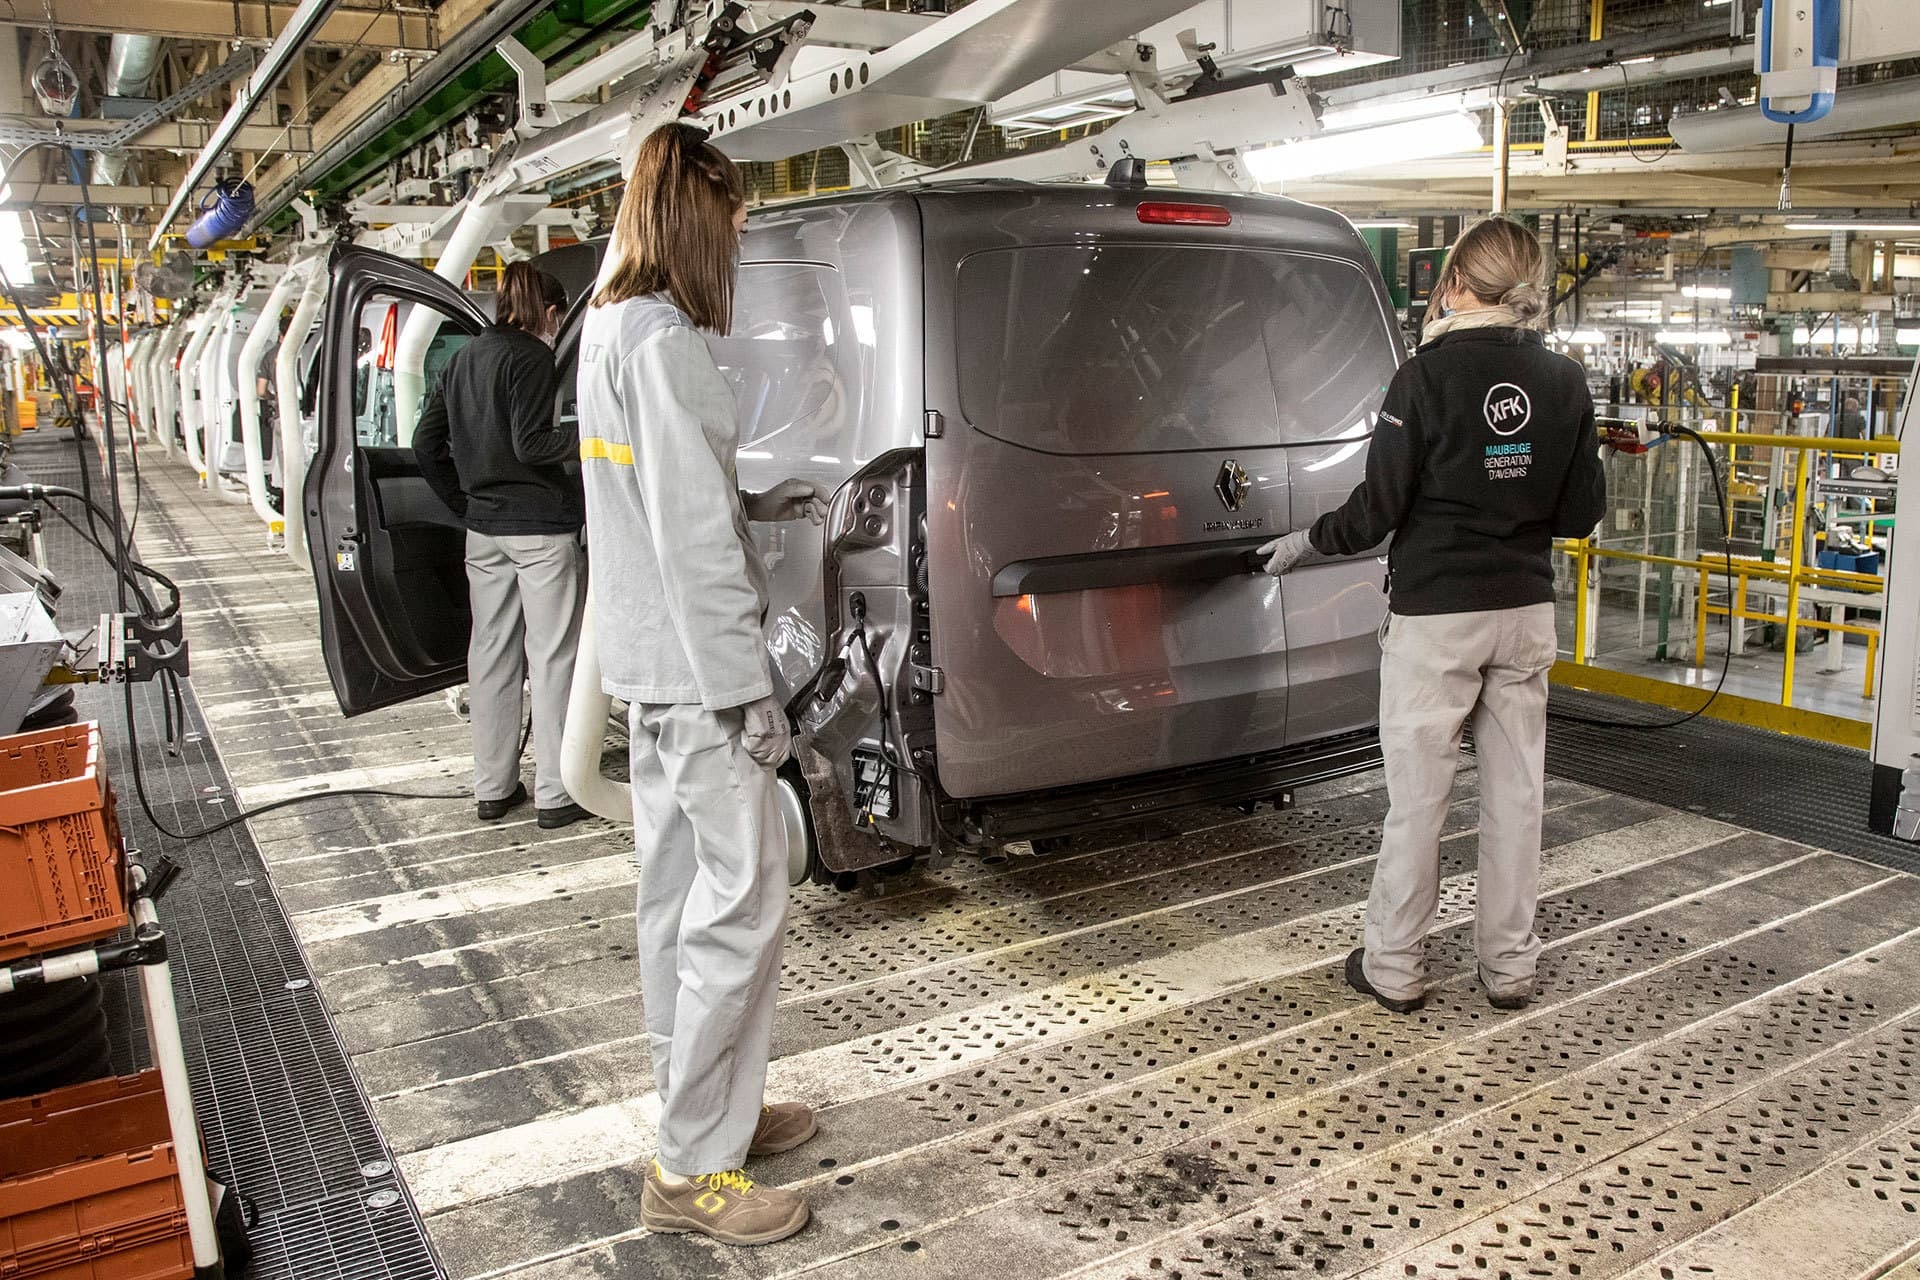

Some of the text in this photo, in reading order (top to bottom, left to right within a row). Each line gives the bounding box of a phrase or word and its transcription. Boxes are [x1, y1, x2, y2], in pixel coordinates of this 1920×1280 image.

[1489, 395, 1525, 423] XFK
[1485, 442, 1532, 456] MAUBEUGE
[1488, 466, 1527, 481] D'AVENIRS
